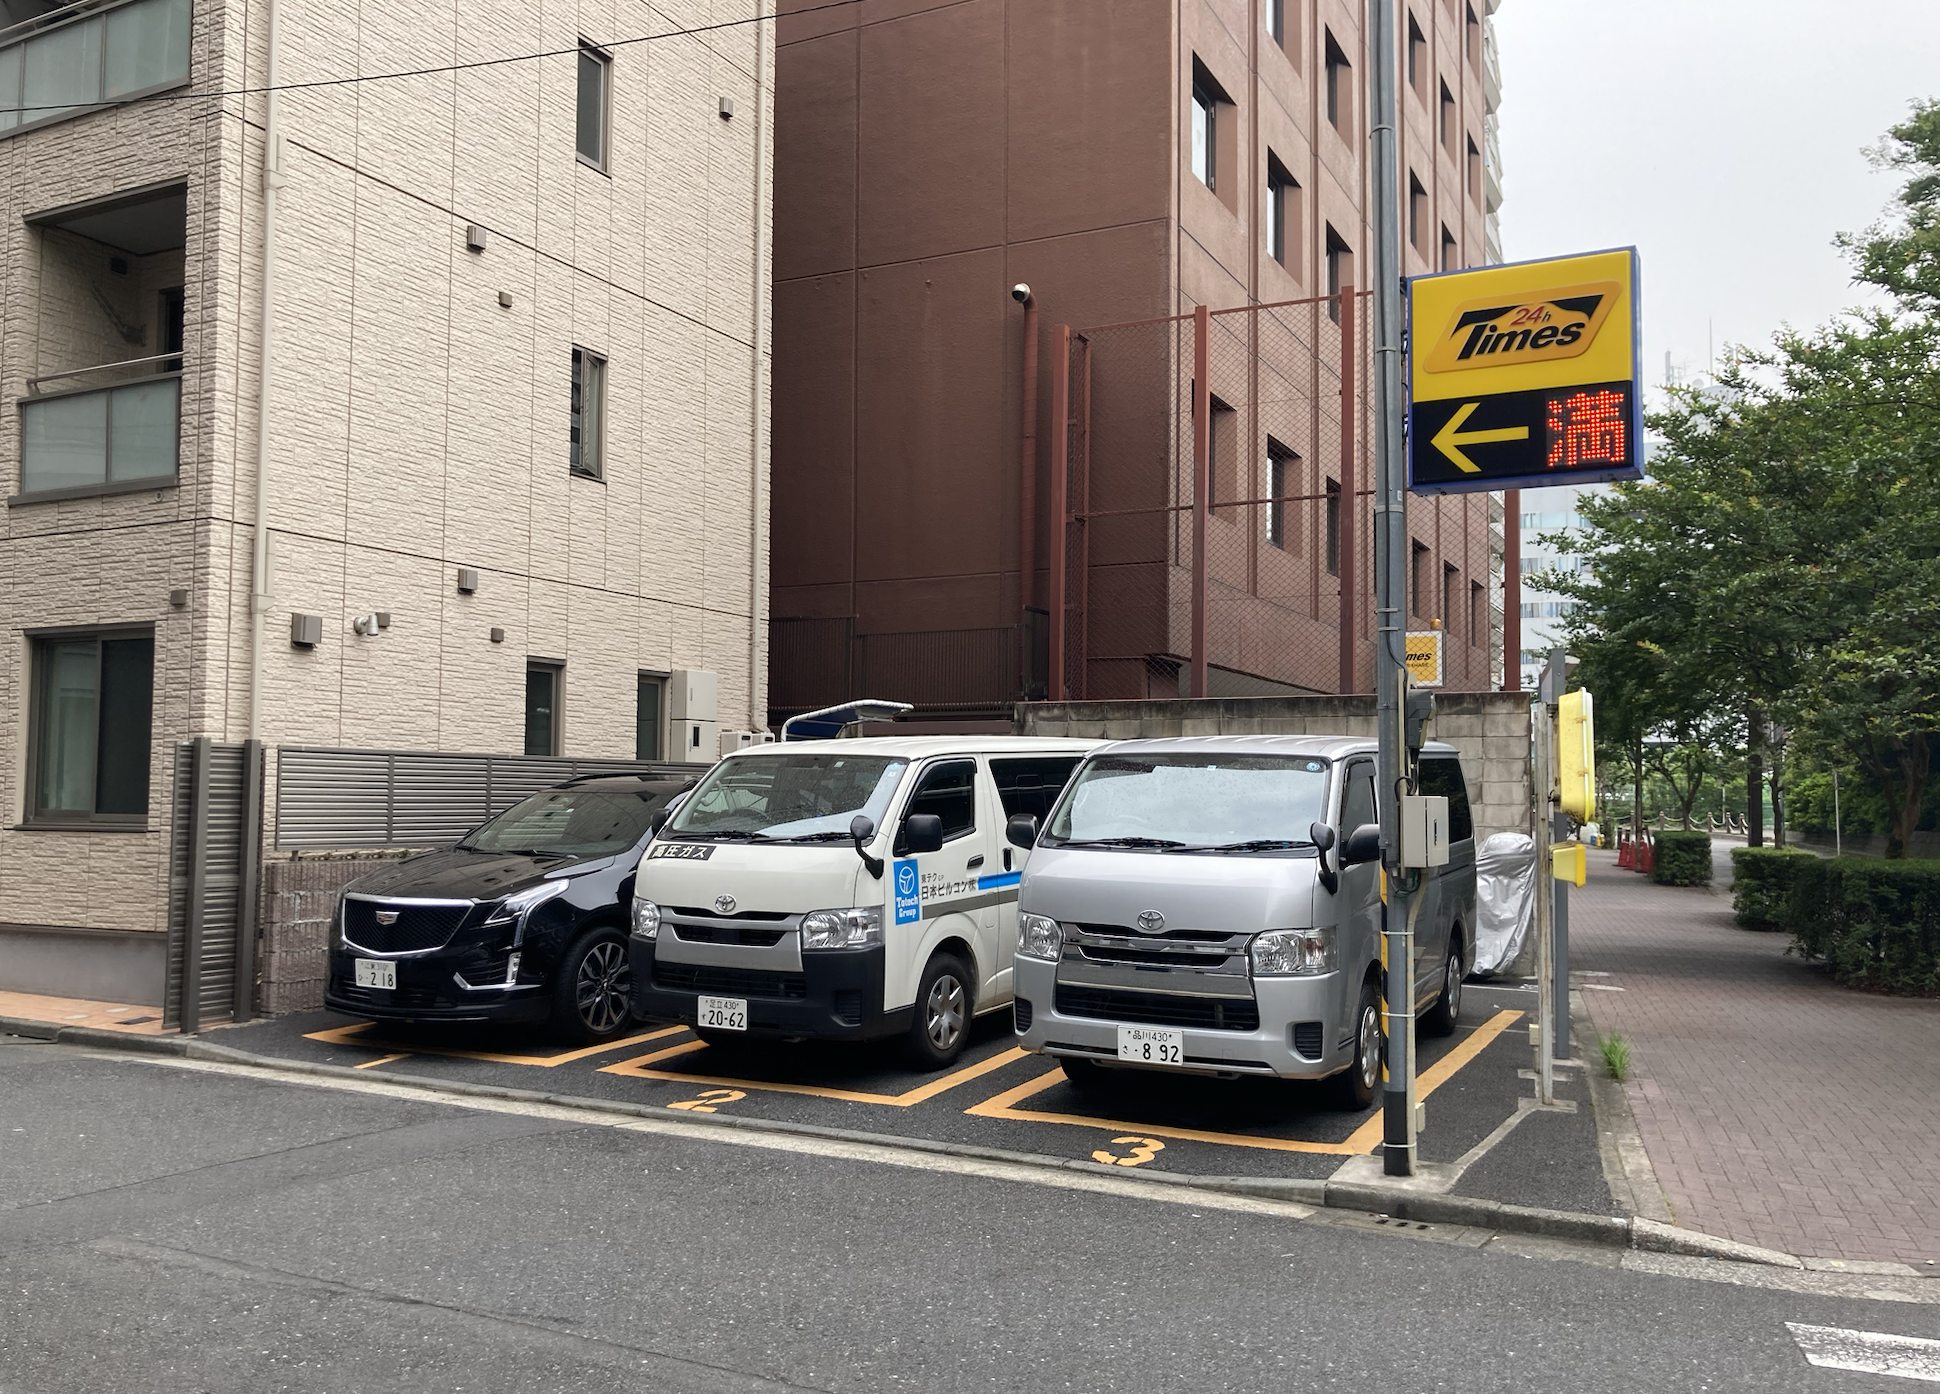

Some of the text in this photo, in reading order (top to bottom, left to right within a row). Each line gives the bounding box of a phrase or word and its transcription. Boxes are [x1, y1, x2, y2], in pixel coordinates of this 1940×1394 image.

[1450, 318, 1587, 361] Times
[1548, 390, 1625, 468] 満
[1405, 652, 1432, 661] mes
[652, 845, 708, 859] 高圧ガス
[895, 894, 919, 908] Totech
[899, 908, 917, 919] Group
[708, 1010, 744, 1028] 20-62
[666, 1089, 747, 1113] 2
[1091, 1136, 1167, 1167] 3
